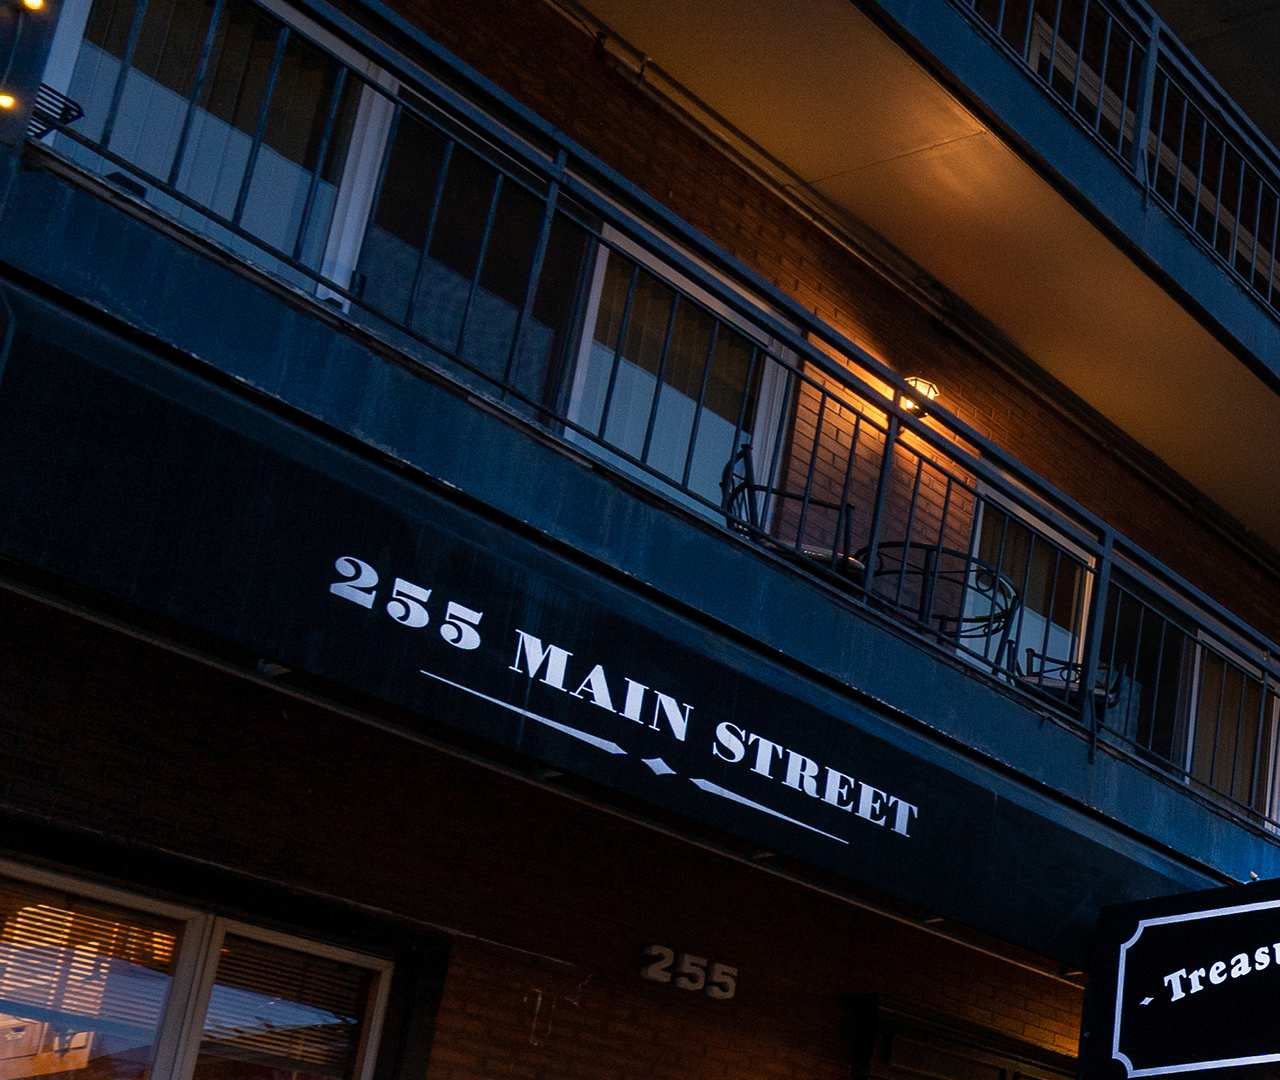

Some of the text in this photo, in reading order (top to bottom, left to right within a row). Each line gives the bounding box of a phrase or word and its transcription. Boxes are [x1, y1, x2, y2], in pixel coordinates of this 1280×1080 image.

[329, 556, 919, 838] 255 MAIN STREET
[640, 944, 738, 1000] 255
